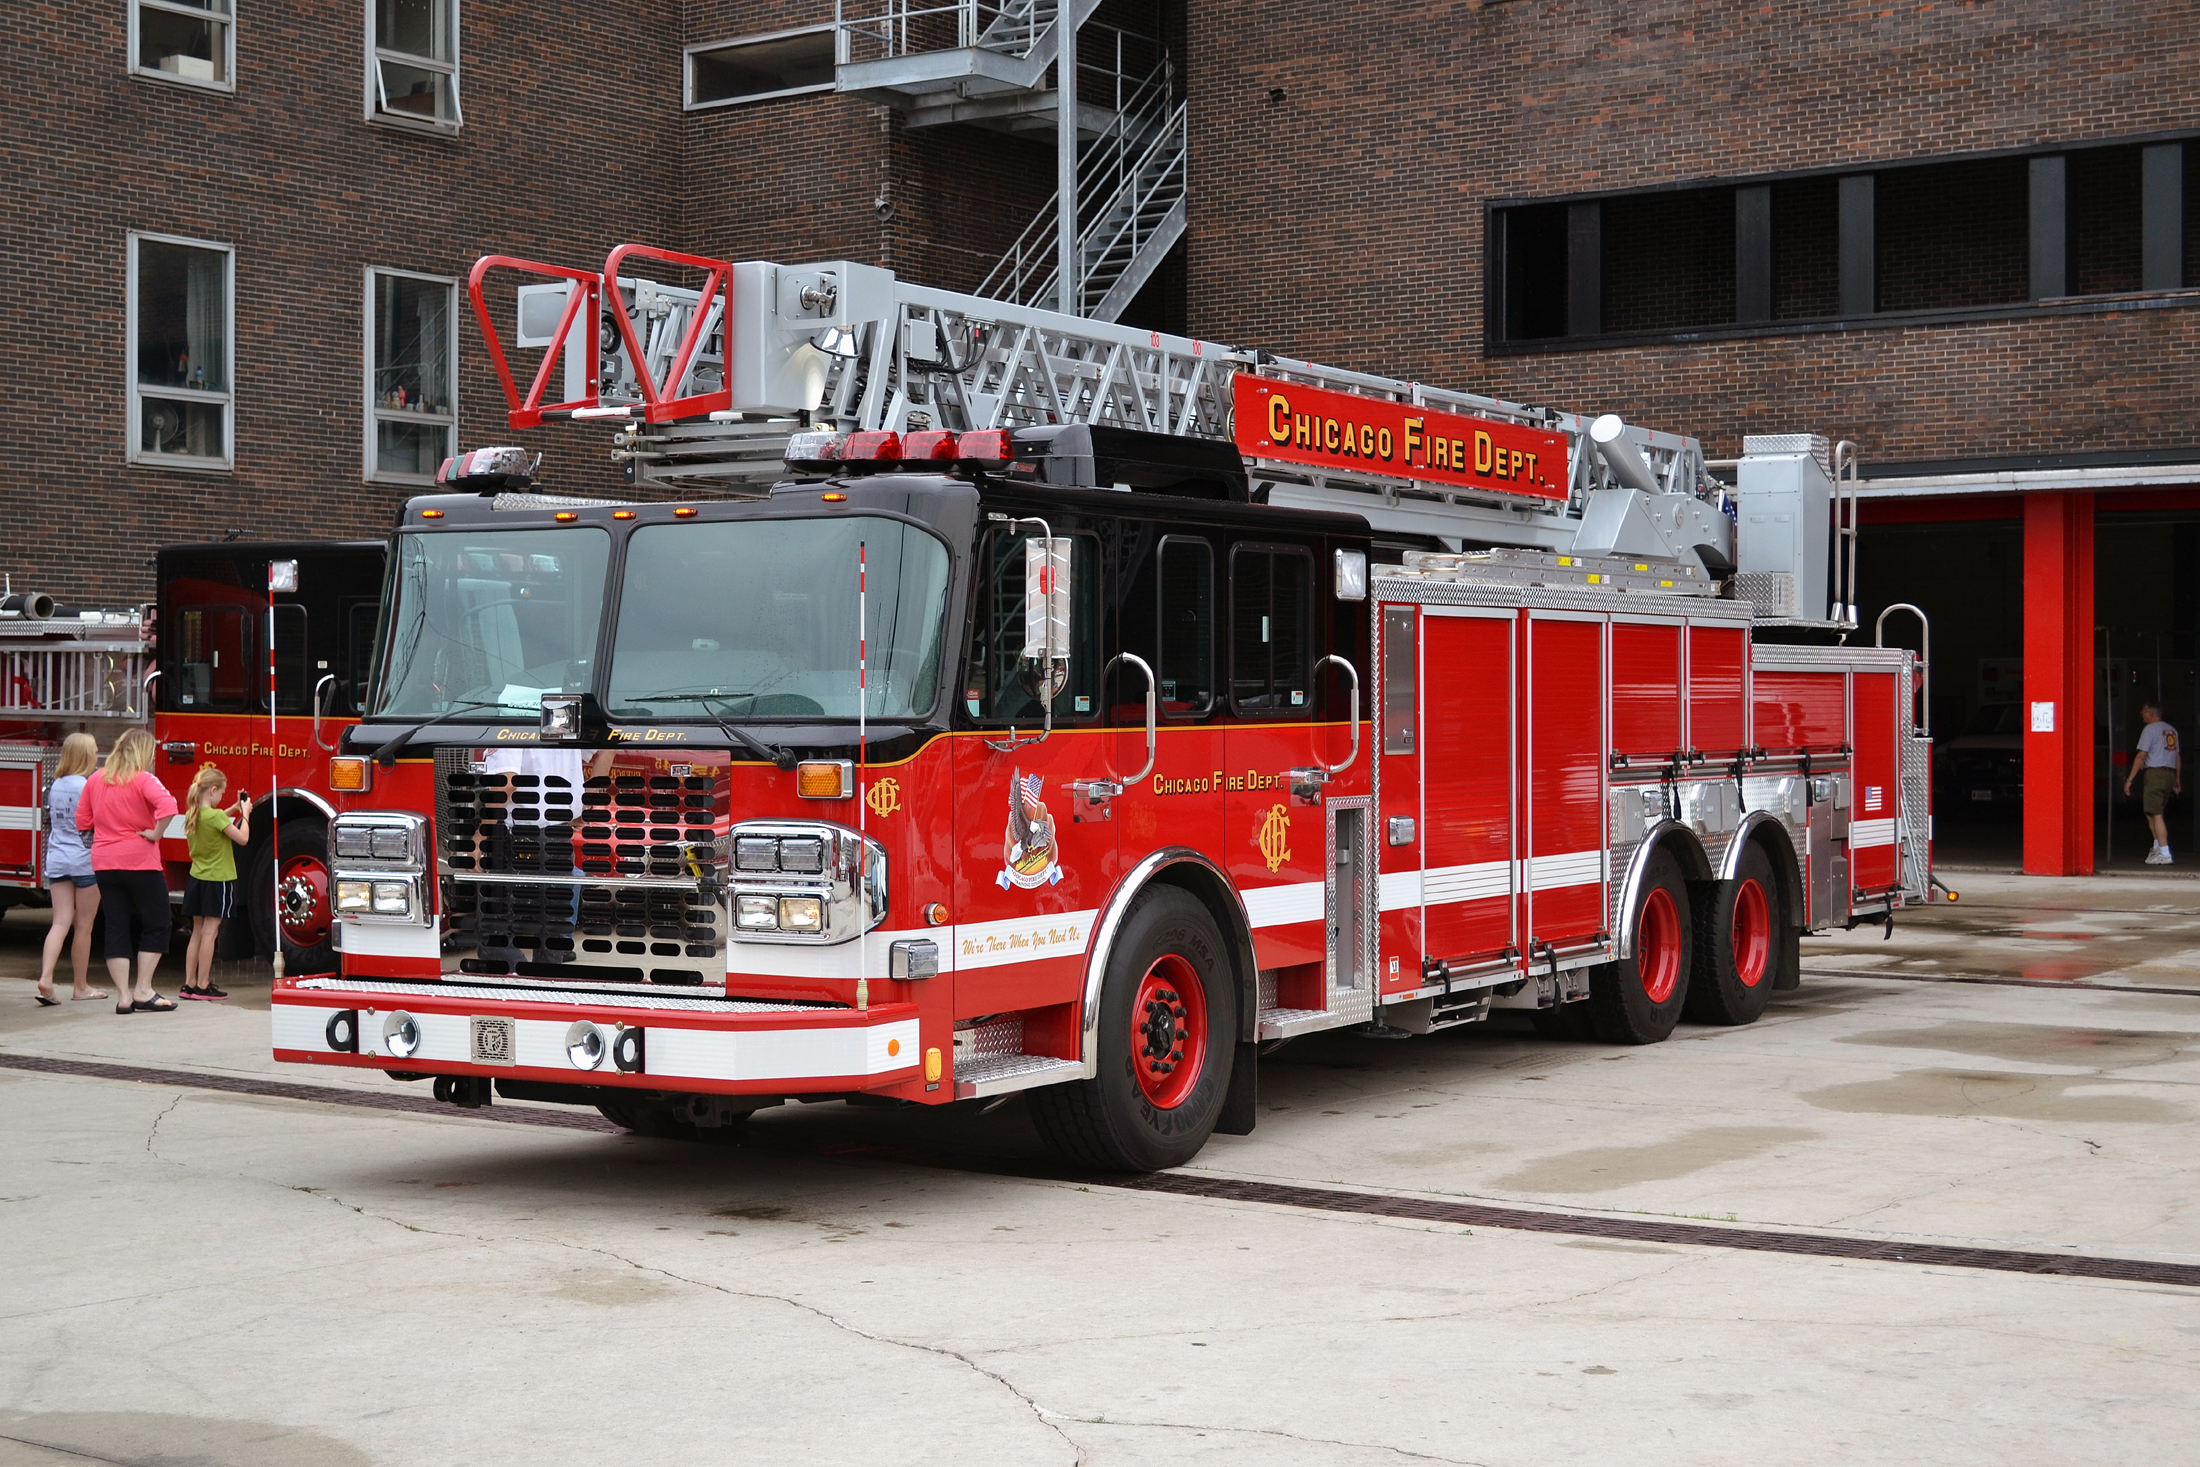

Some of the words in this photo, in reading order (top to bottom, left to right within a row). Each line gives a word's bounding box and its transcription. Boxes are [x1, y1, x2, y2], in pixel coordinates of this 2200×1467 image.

[1268, 394, 1393, 462] CHICAGO
[1404, 417, 1467, 473] FIRE
[1474, 429, 1546, 485] DEPT.
[497, 728, 540, 741] CHICA
[607, 728, 642, 741] FIRE
[644, 728, 687, 741] DEPT.
[204, 741, 248, 756] CHICAGO
[251, 743, 274, 757] FIRE
[278, 743, 312, 759] DEPT.
[1153, 773, 1209, 796] CHICAGO
[1213, 770, 1245, 793] FIRE
[1247, 769, 1284, 792] DEPT.
[962, 938, 984, 955] We're
[986, 935, 1006, 952] There
[1009, 933, 1029, 949] When
[1032, 930, 1046, 950] You
[1048, 928, 1067, 945] Need
[1068, 925, 1080, 941] Us
